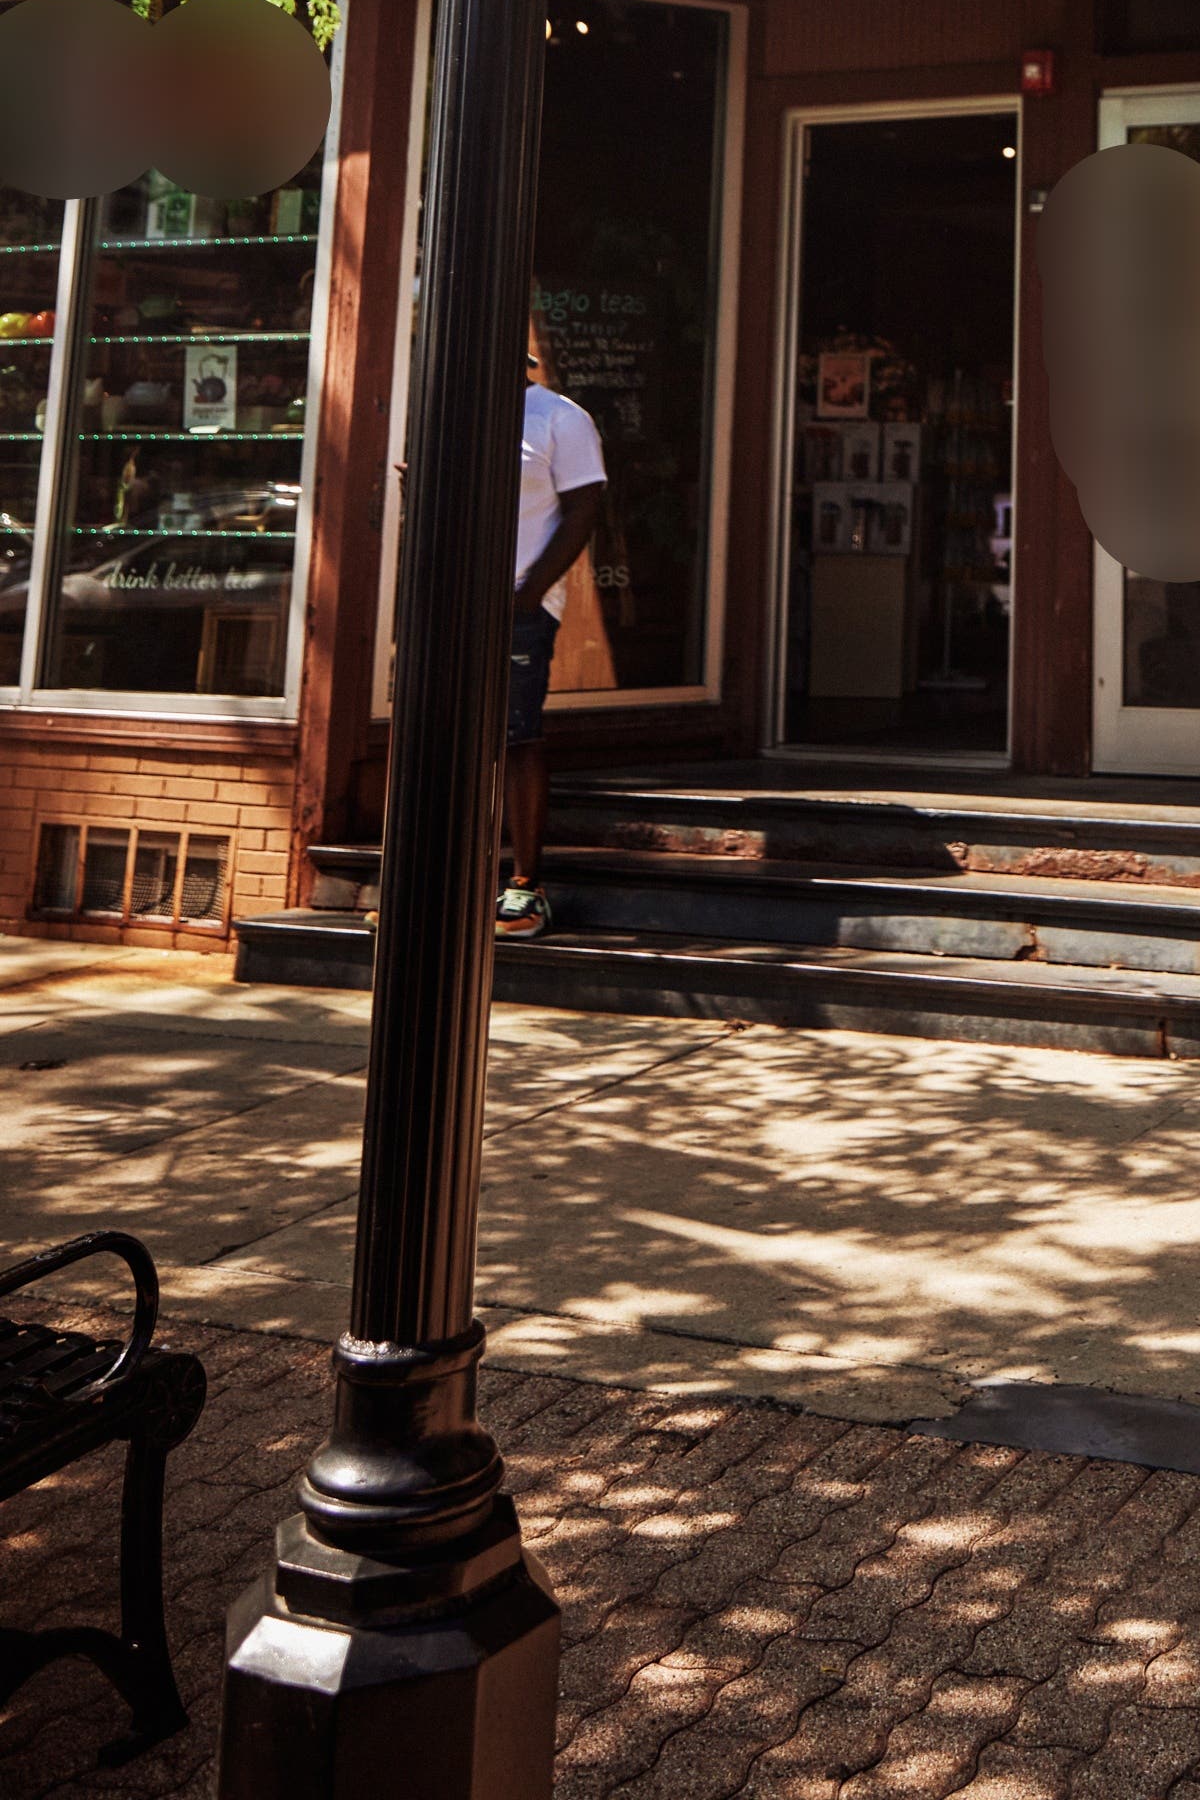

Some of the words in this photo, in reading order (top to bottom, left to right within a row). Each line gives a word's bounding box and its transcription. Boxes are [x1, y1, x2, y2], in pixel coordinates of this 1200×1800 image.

[103, 561, 158, 589] drink
[162, 561, 217, 590] better
[223, 565, 256, 591] tea
